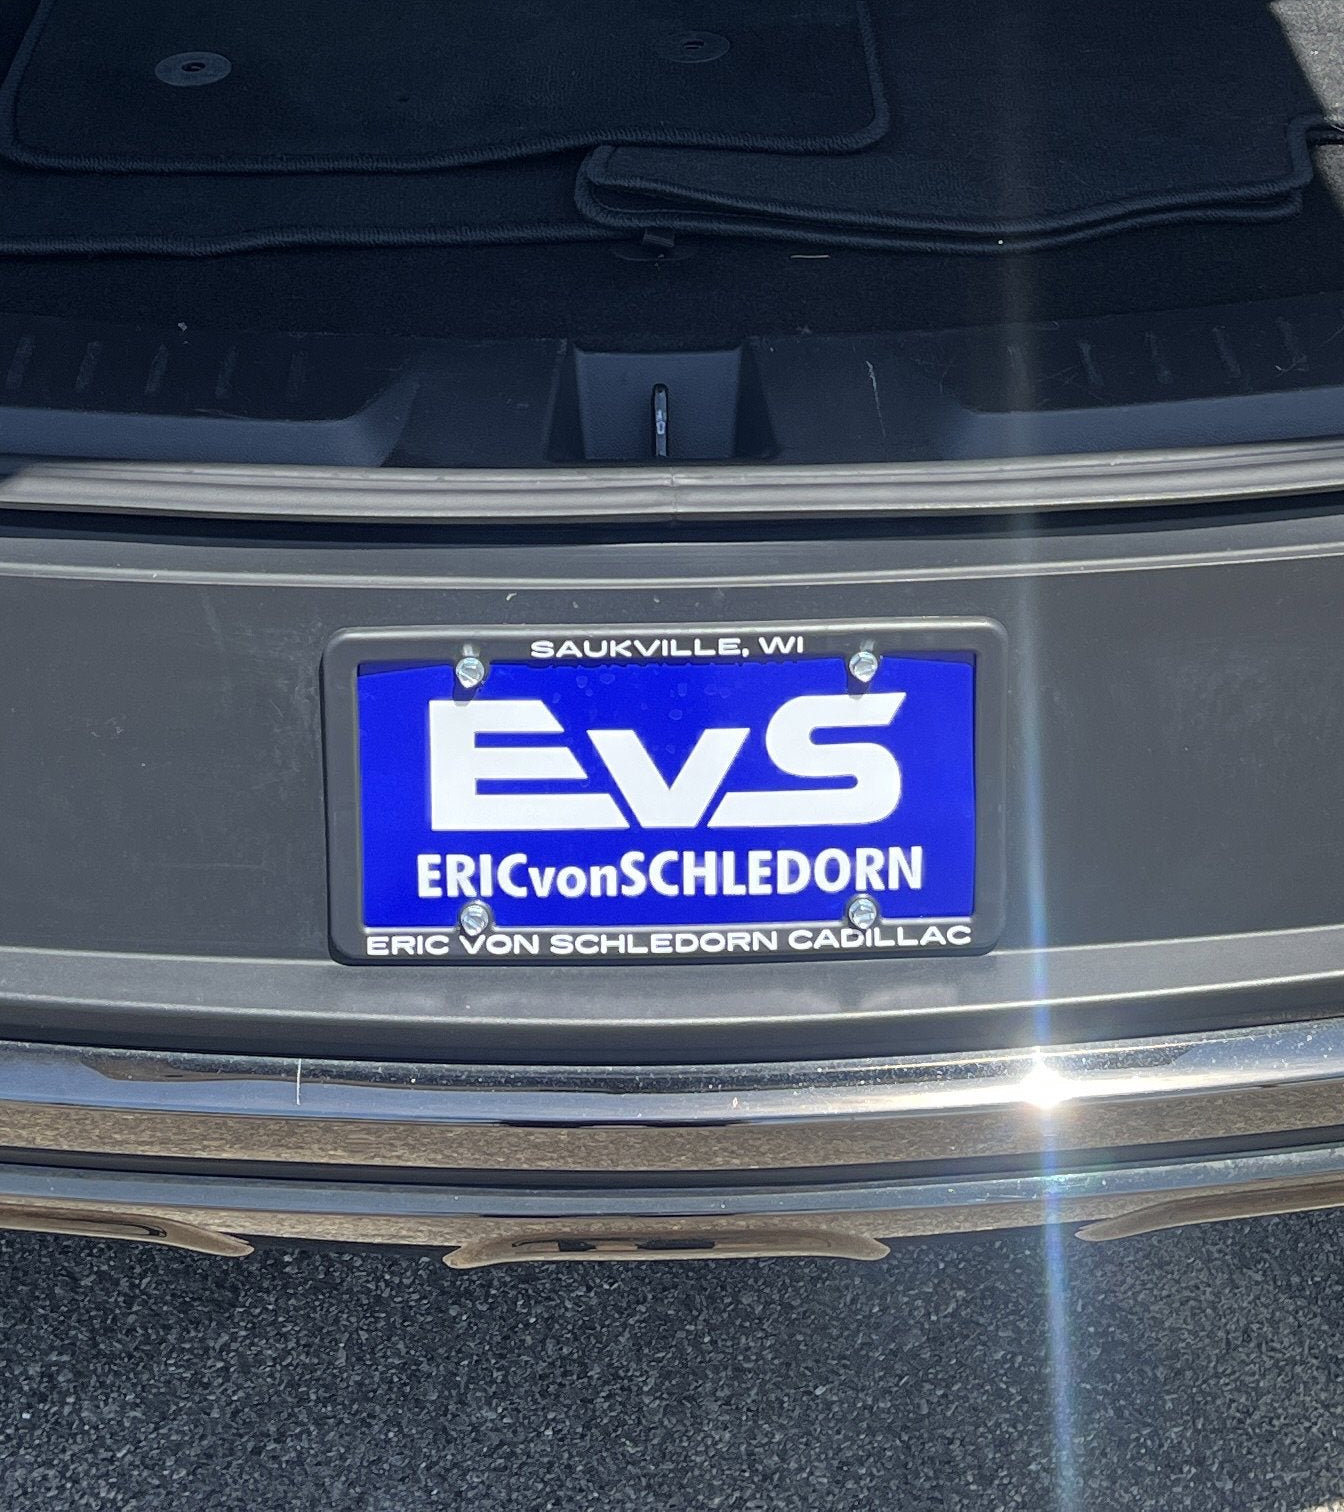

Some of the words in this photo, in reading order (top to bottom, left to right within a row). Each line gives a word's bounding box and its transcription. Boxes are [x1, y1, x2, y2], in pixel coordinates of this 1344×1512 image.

[530, 639, 750, 658] SAUKVILLE,
[757, 636, 804, 654] WI
[416, 845, 923, 898] ERICvonSCHLEDORN
[366, 935, 450, 955] ERIC
[459, 934, 540, 955] VON
[549, 930, 778, 955] SCHLEDORN
[787, 925, 972, 950] CADILLAC
